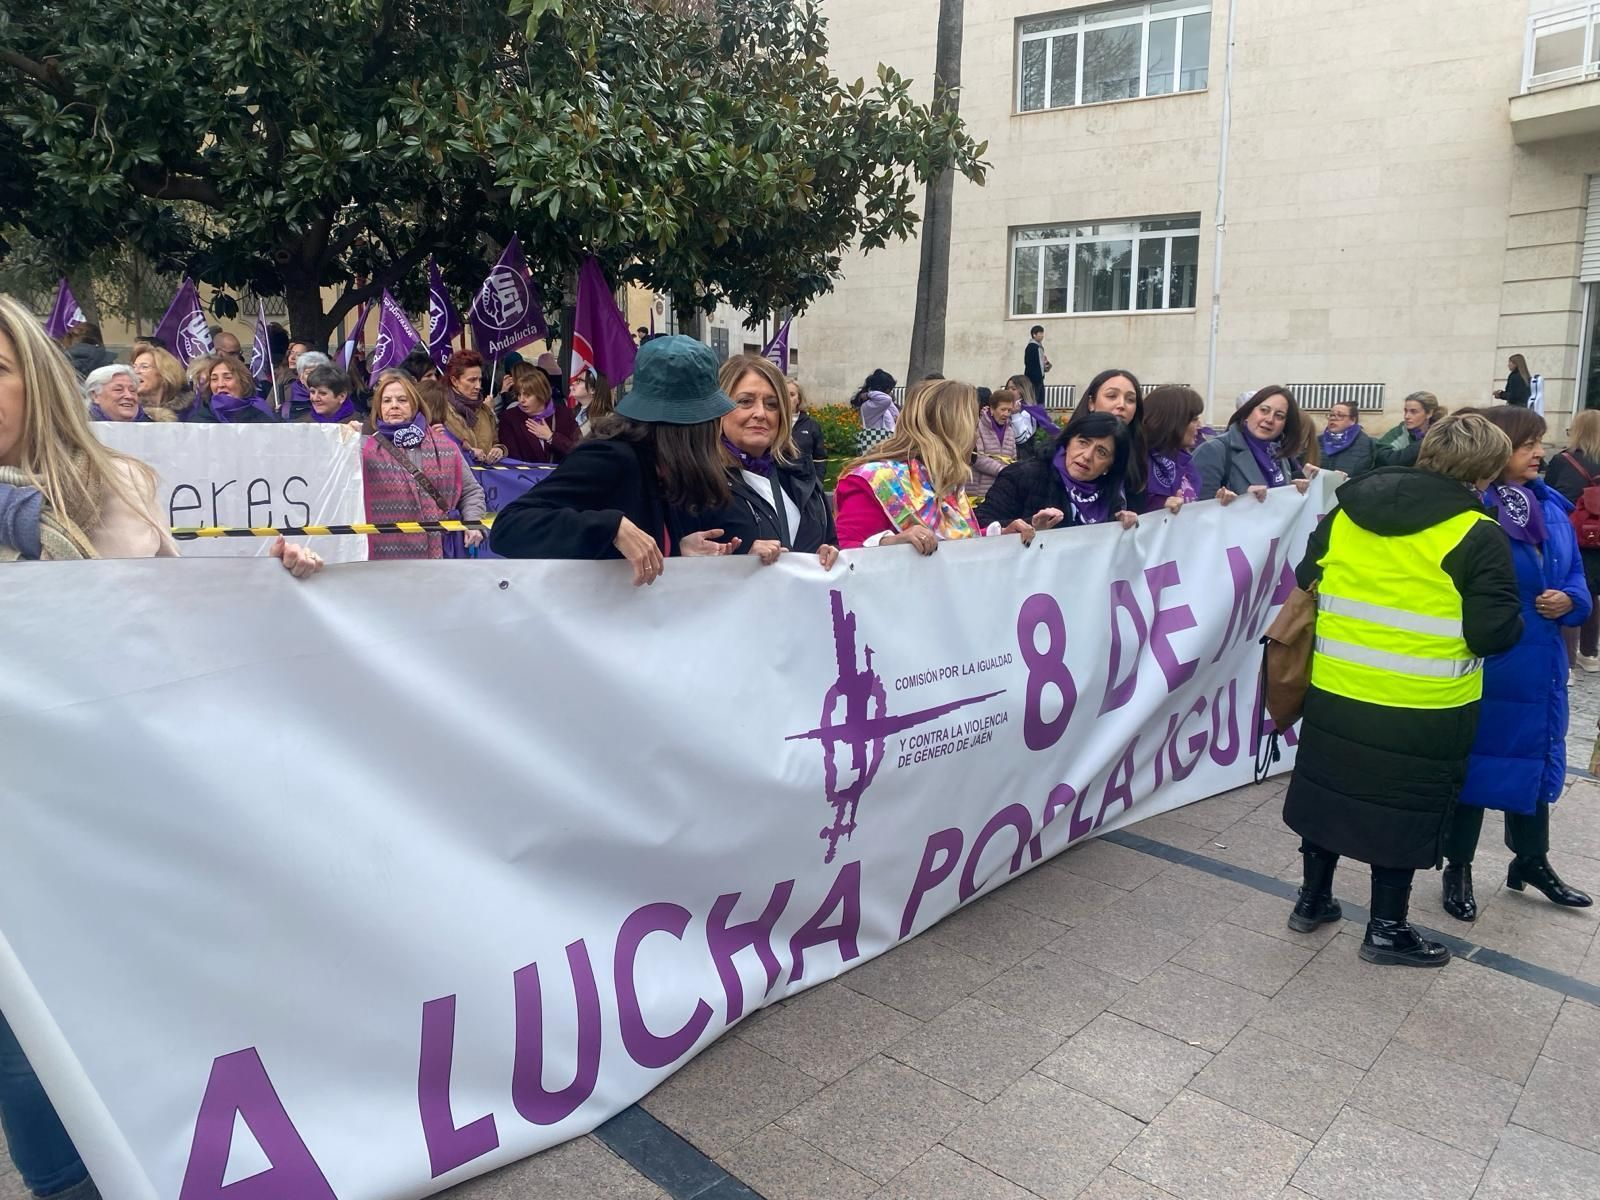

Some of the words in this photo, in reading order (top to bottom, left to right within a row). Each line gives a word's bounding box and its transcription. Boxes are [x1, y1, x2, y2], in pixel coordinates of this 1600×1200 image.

[491, 272, 524, 318] UGT
[169, 475, 311, 541] eres
[895, 668, 938, 691] COMISIÓN
[939, 665, 959, 680] POR
[962, 663, 976, 676] LA
[977, 653, 1013, 673] IGUALDAD
[1016, 592, 1078, 751] 8
[1097, 560, 1201, 719] DE
[897, 753, 912, 768] DE
[913, 743, 955, 764] GÉNERO
[956, 738, 970, 752] DE
[970, 730, 993, 748] JAÉN
[899, 738, 907, 752] Y
[909, 728, 949, 750] CONTRA
[951, 724, 963, 738] LA
[964, 711, 1008, 734] VIOLENCIA
[417, 860, 862, 1179] LUCHA
[1067, 734, 1141, 843] LA
